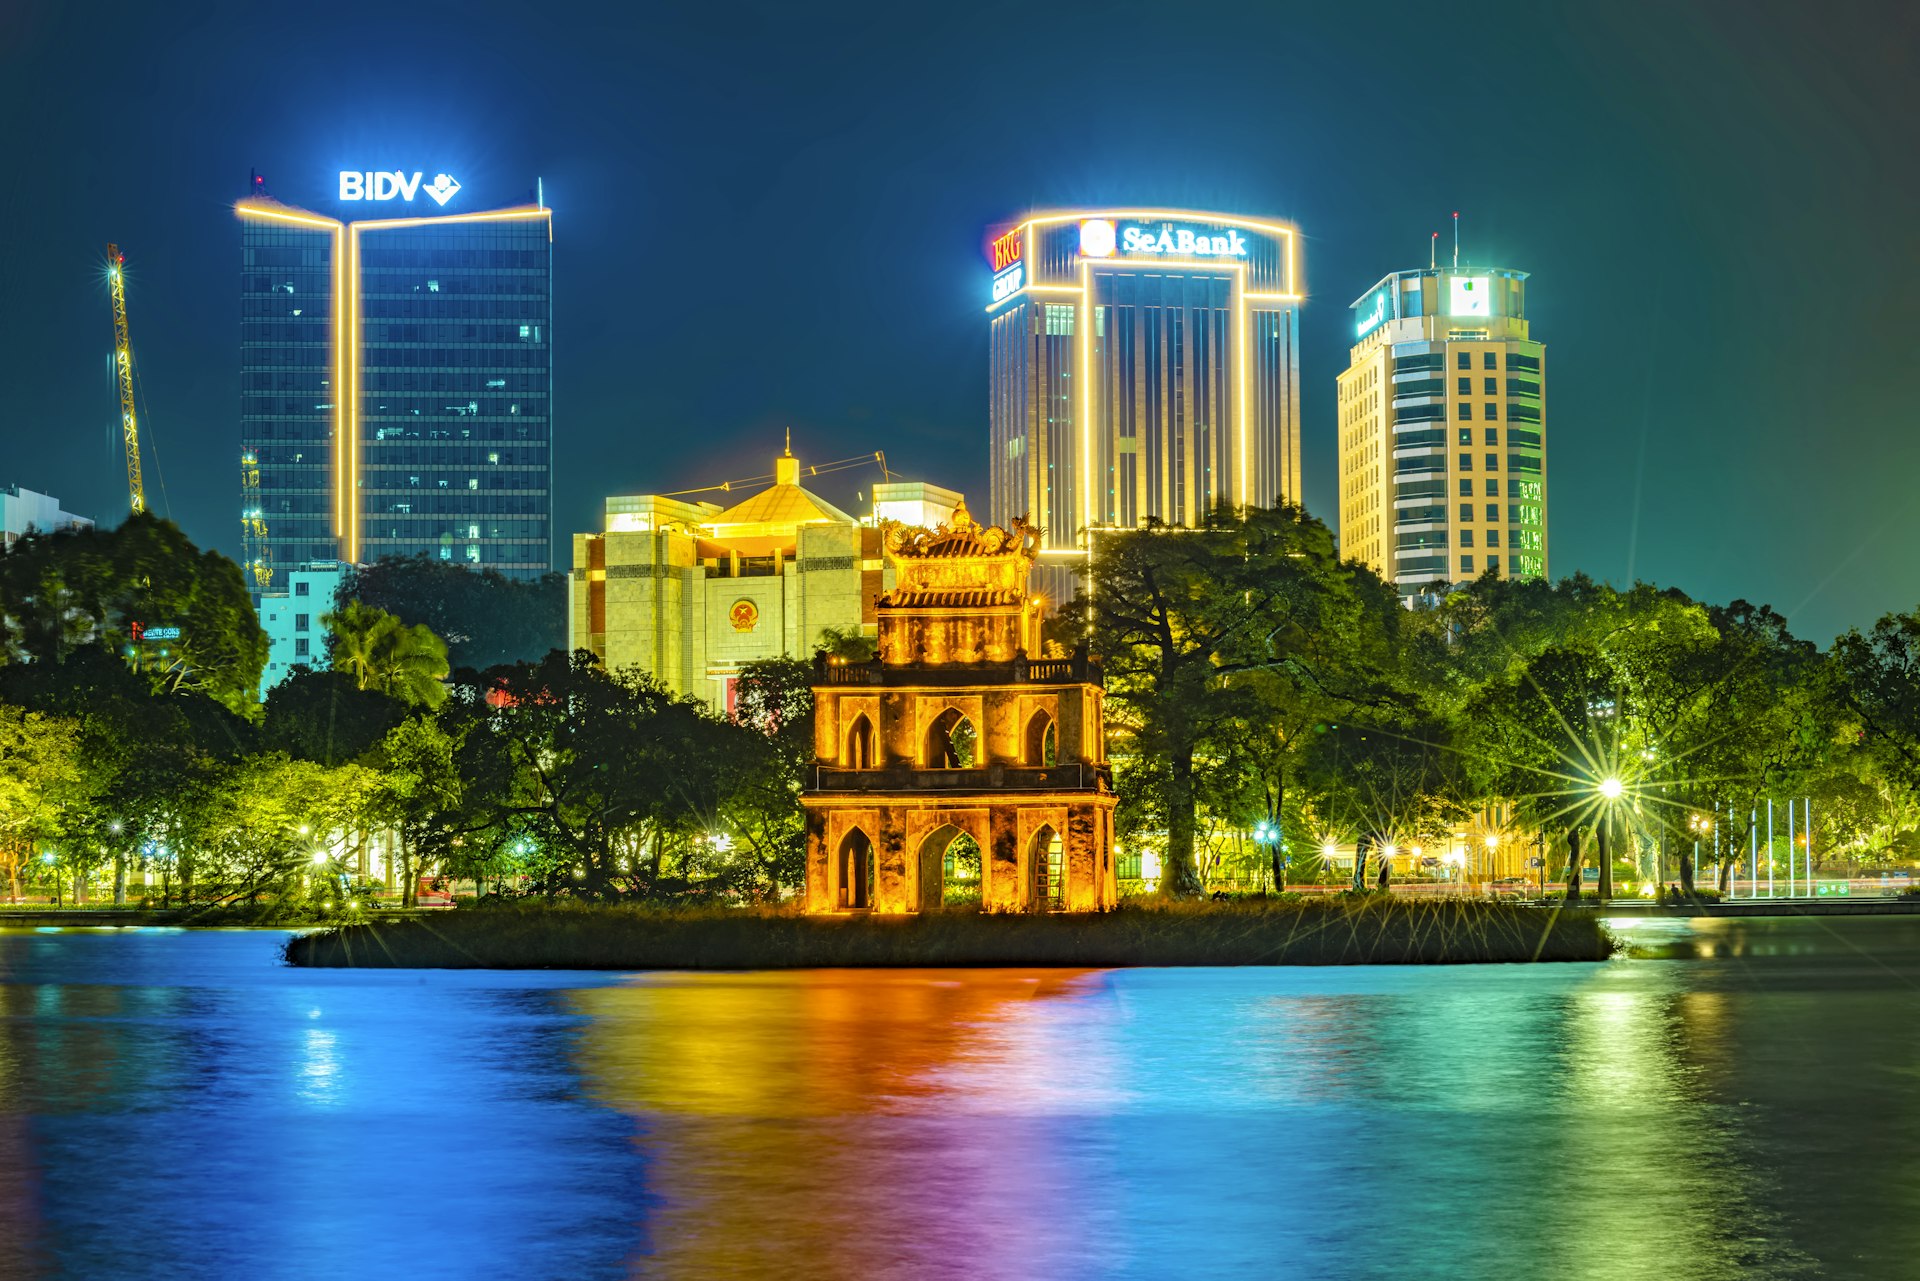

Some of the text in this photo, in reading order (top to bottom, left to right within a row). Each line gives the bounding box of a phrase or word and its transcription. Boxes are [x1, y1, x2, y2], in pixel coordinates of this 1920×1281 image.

[339, 171, 422, 201] BIDV
[993, 229, 1021, 272] BRG
[1123, 227, 1246, 255] SeABank
